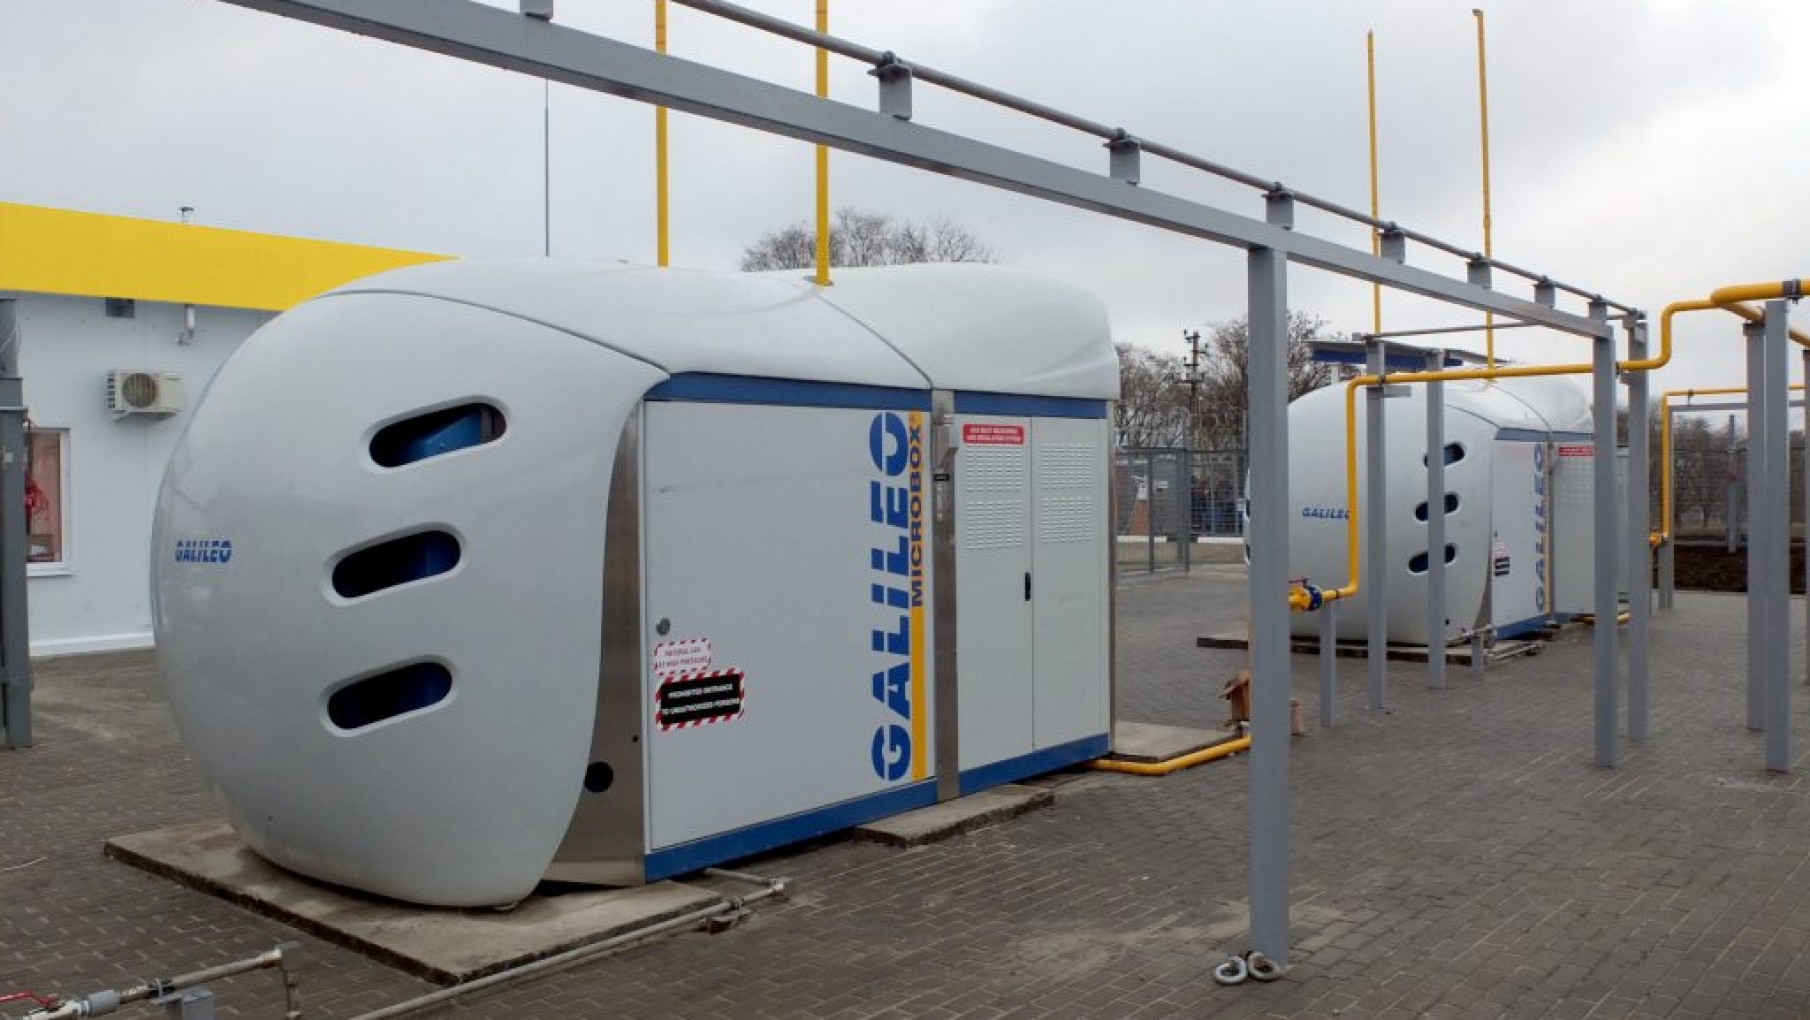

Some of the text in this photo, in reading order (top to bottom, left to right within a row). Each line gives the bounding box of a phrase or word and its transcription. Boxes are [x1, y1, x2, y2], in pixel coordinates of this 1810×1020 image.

[175, 540, 232, 563] GALILEO
[869, 412, 911, 781] GALILEO
[910, 427, 923, 607] MICROBOX
